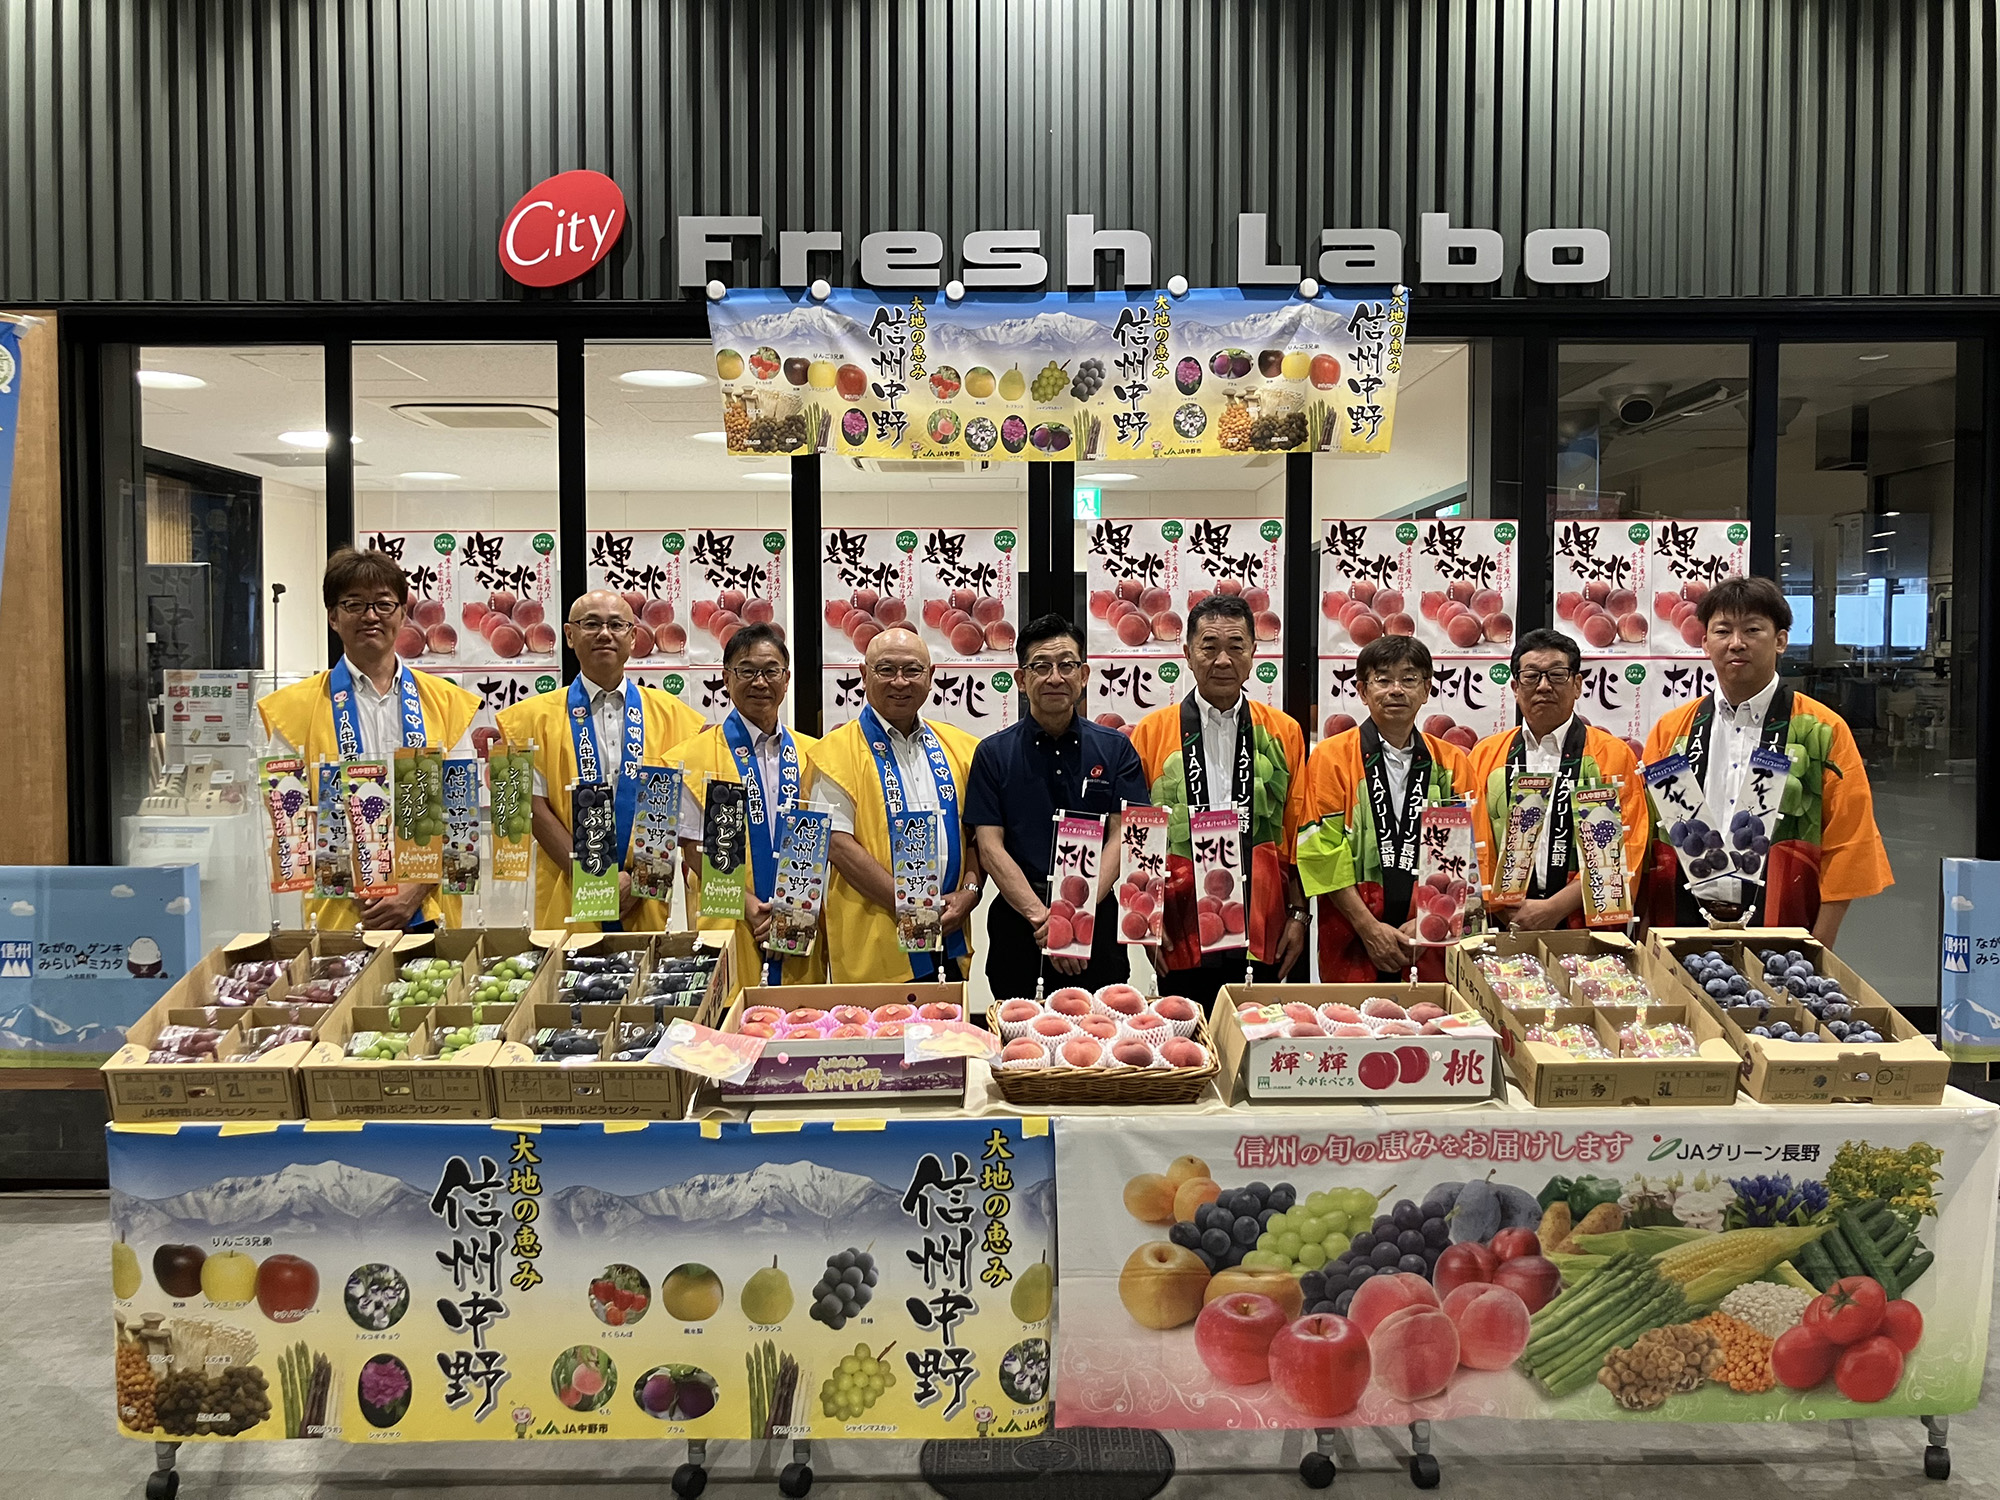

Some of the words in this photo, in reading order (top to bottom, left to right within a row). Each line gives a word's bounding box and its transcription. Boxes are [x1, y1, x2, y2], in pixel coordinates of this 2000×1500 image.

[505, 200, 616, 267] City
[678, 214, 1152, 286] Fresh
[1238, 213, 1611, 286] Labo
[909, 296, 927, 380] 大地の恵み
[1153, 295, 1170, 379] 大地の恵み
[869, 306, 908, 448] 信州中野
[1113, 307, 1150, 449] 信州中野
[1347, 302, 1384, 443] 信州中野
[168, 685, 232, 698] 紙製青果容器
[933, 672, 989, 720] 桃
[1100, 662, 1156, 711] 桃
[1430, 664, 1487, 712] 桃
[339, 711, 359, 763] JA中野市
[403, 681, 426, 748] 信州中野
[579, 728, 597, 782] JA中野市
[625, 707, 643, 780] 信州中野
[922, 733, 955, 801] 信州中野
[415, 769, 428, 817] シャイン
[445, 766, 469, 839] 信州中野
[508, 767, 520, 815] シャイン
[746, 768, 764, 825] JA中野市
[782, 745, 799, 817] 信州中
[883, 761, 903, 813] JA中野市
[1654, 774, 1703, 819] プルーン
[1751, 767, 1776, 817] プルーン
[400, 783, 414, 840] マスカット
[495, 781, 507, 837] マスカット
[647, 773, 671, 847] 信州中野
[1370, 765, 1396, 868] JAグリーン長野
[1397, 771, 1425, 872] JAグリーン長野
[1551, 768, 1573, 867] JAグリーン長野
[583, 806, 606, 875] ぶどう
[715, 803, 736, 871] ぶどう
[788, 816, 819, 896] 信州中野
[904, 817, 927, 895] 信州中野
[1056, 841, 1097, 878] 桃
[1194, 836, 1239, 873] 桃
[1, 942, 32, 959] 信州
[39, 942, 77, 954] ながの
[88, 942, 124, 954] ゲンキ
[39, 958, 77, 971] みらい
[89, 958, 124, 970] ミカタ
[1945, 937, 1969, 954] 信州
[226, 1082, 245, 1098] 2L
[802, 1068, 882, 1091] 信州中野
[1270, 1051, 1301, 1076] 輝
[1317, 1051, 1348, 1076] 輝
[1442, 1048, 1485, 1086] 桃
[1296, 1075, 1355, 1087] 今がたべごろ
[1657, 1081, 1673, 1097] 3L
[142, 1107, 269, 1119] JA中野市ぶどうセンター
[337, 1105, 463, 1116] JA中野市ぶどうセンター
[527, 1105, 652, 1116] JA中野市ぶどうセンター
[1235, 1129, 1632, 1169] 信州の旬の恵みをお届けします
[1676, 1141, 1821, 1163] JAグリーン長野
[508, 1133, 543, 1291] 大地の恵み
[980, 1129, 1015, 1287] 大地の恵み
[211, 1236, 273, 1247] りんご3兄弟
[430, 1155, 506, 1421] 信州中野
[902, 1152, 979, 1420] 信州中野
[562, 1423, 608, 1434] JA中野市
[844, 1424, 898, 1432] シャインマスカット
